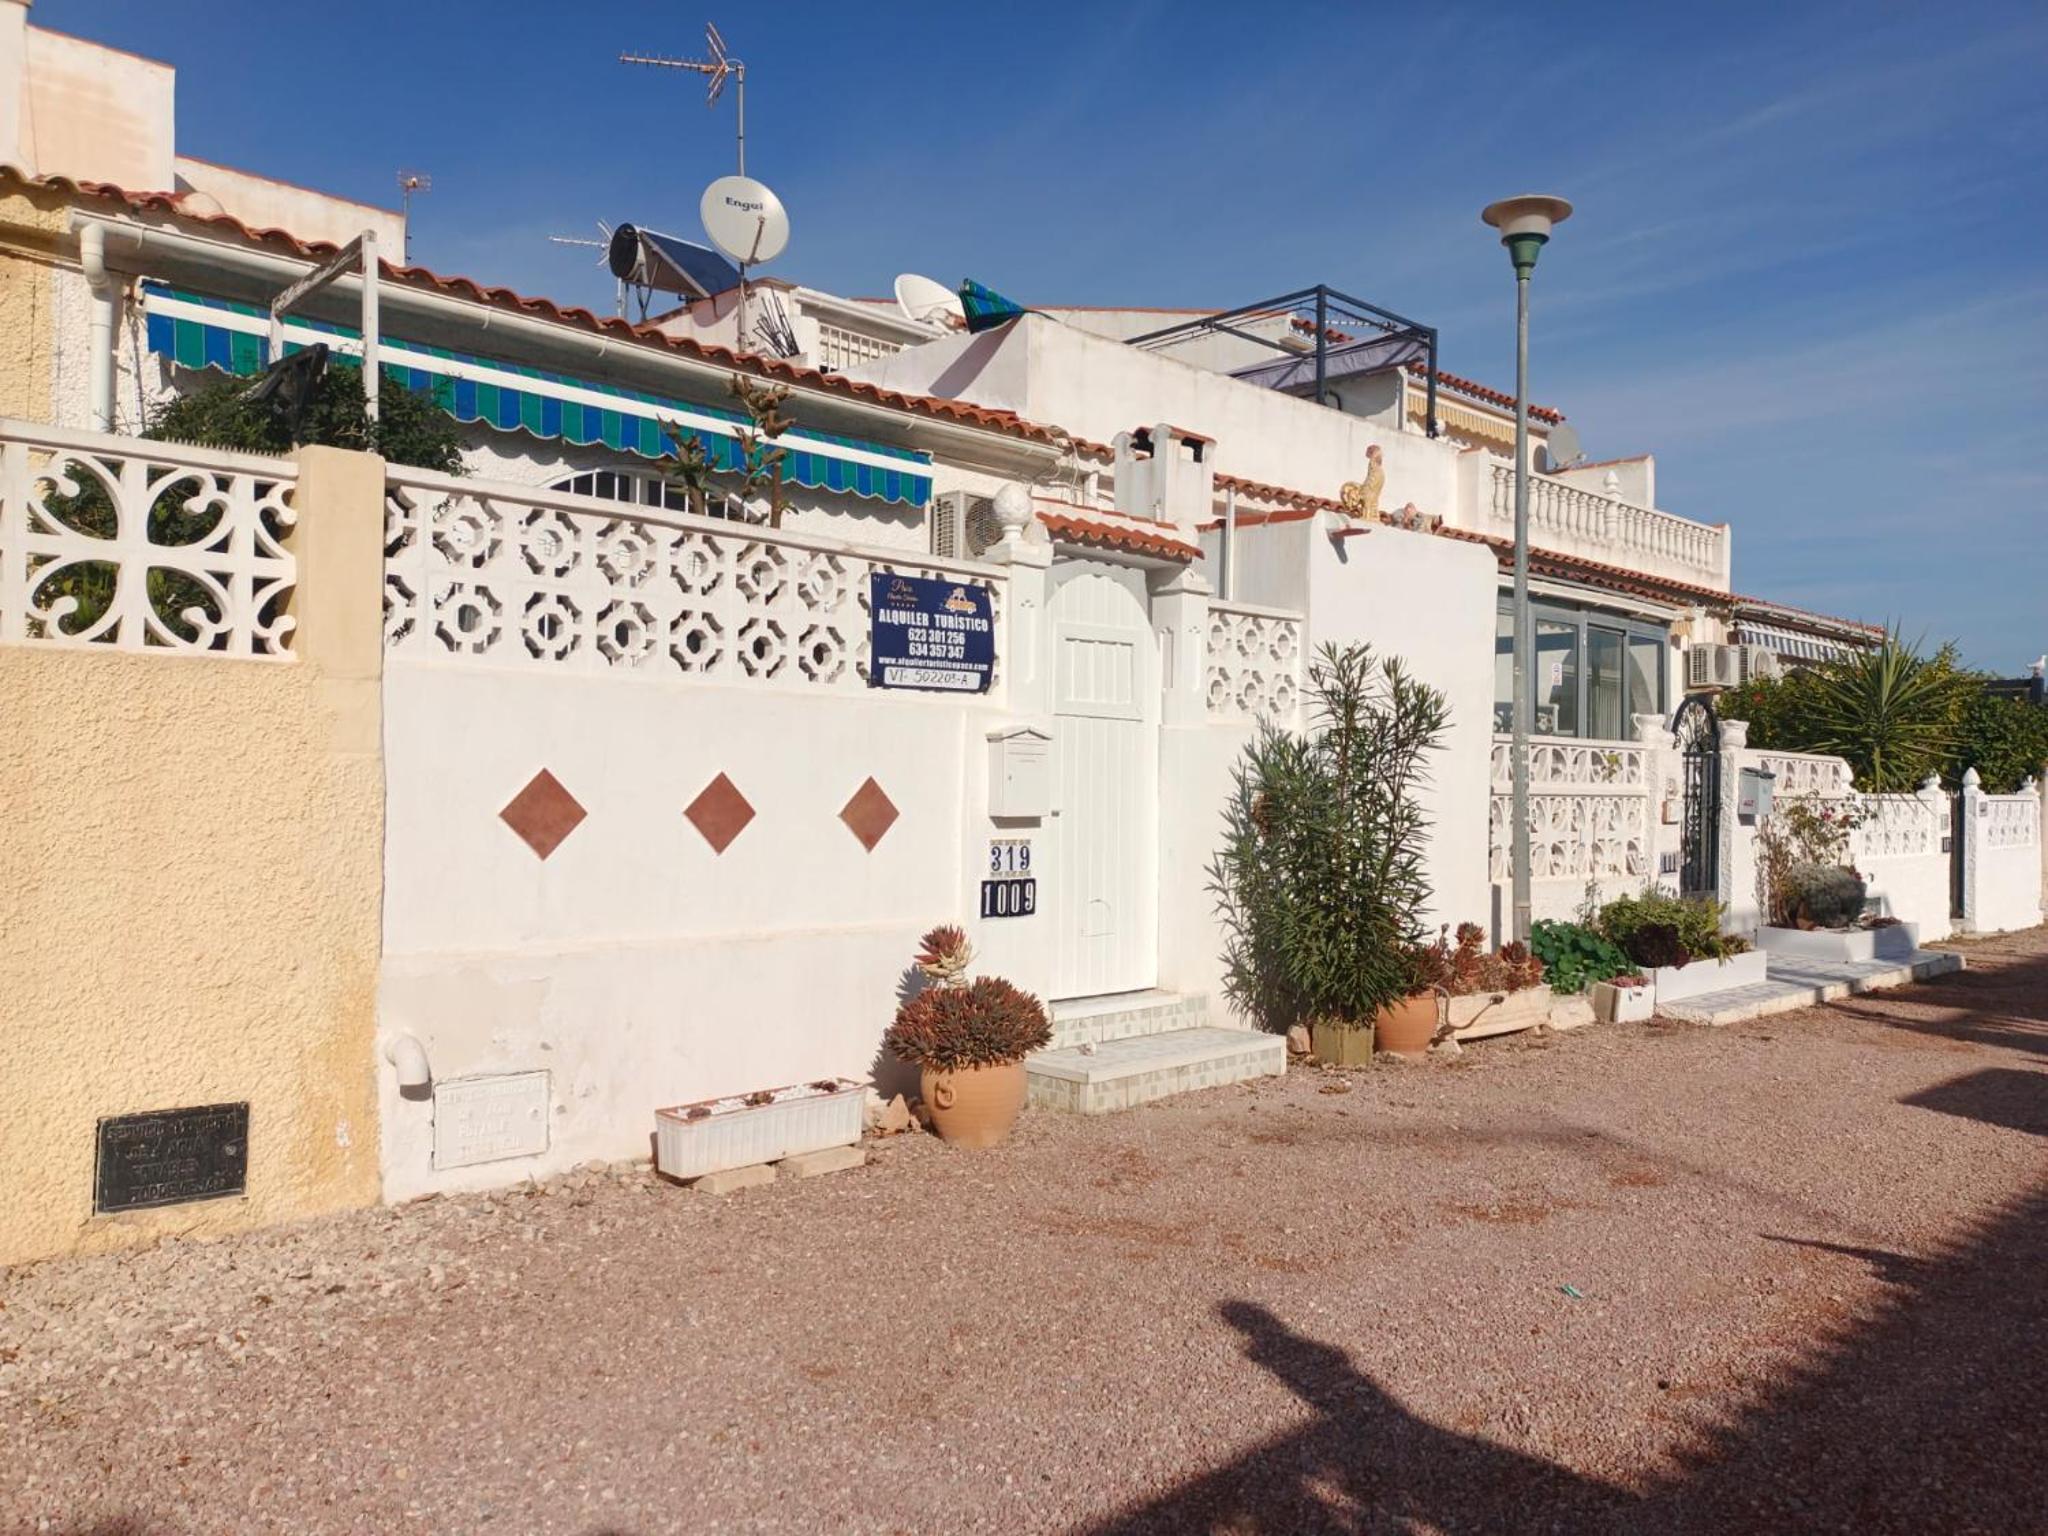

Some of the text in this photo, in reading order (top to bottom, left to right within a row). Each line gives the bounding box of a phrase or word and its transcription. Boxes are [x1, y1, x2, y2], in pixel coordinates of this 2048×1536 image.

[725, 196, 763, 212] Engel
[878, 608, 988, 632] ALQUILER TURÍSTICO
[908, 627, 965, 645] 623 301 256
[909, 642, 964, 659] 634 357 347
[991, 845, 1030, 871] 319
[984, 882, 1034, 915] 1009
